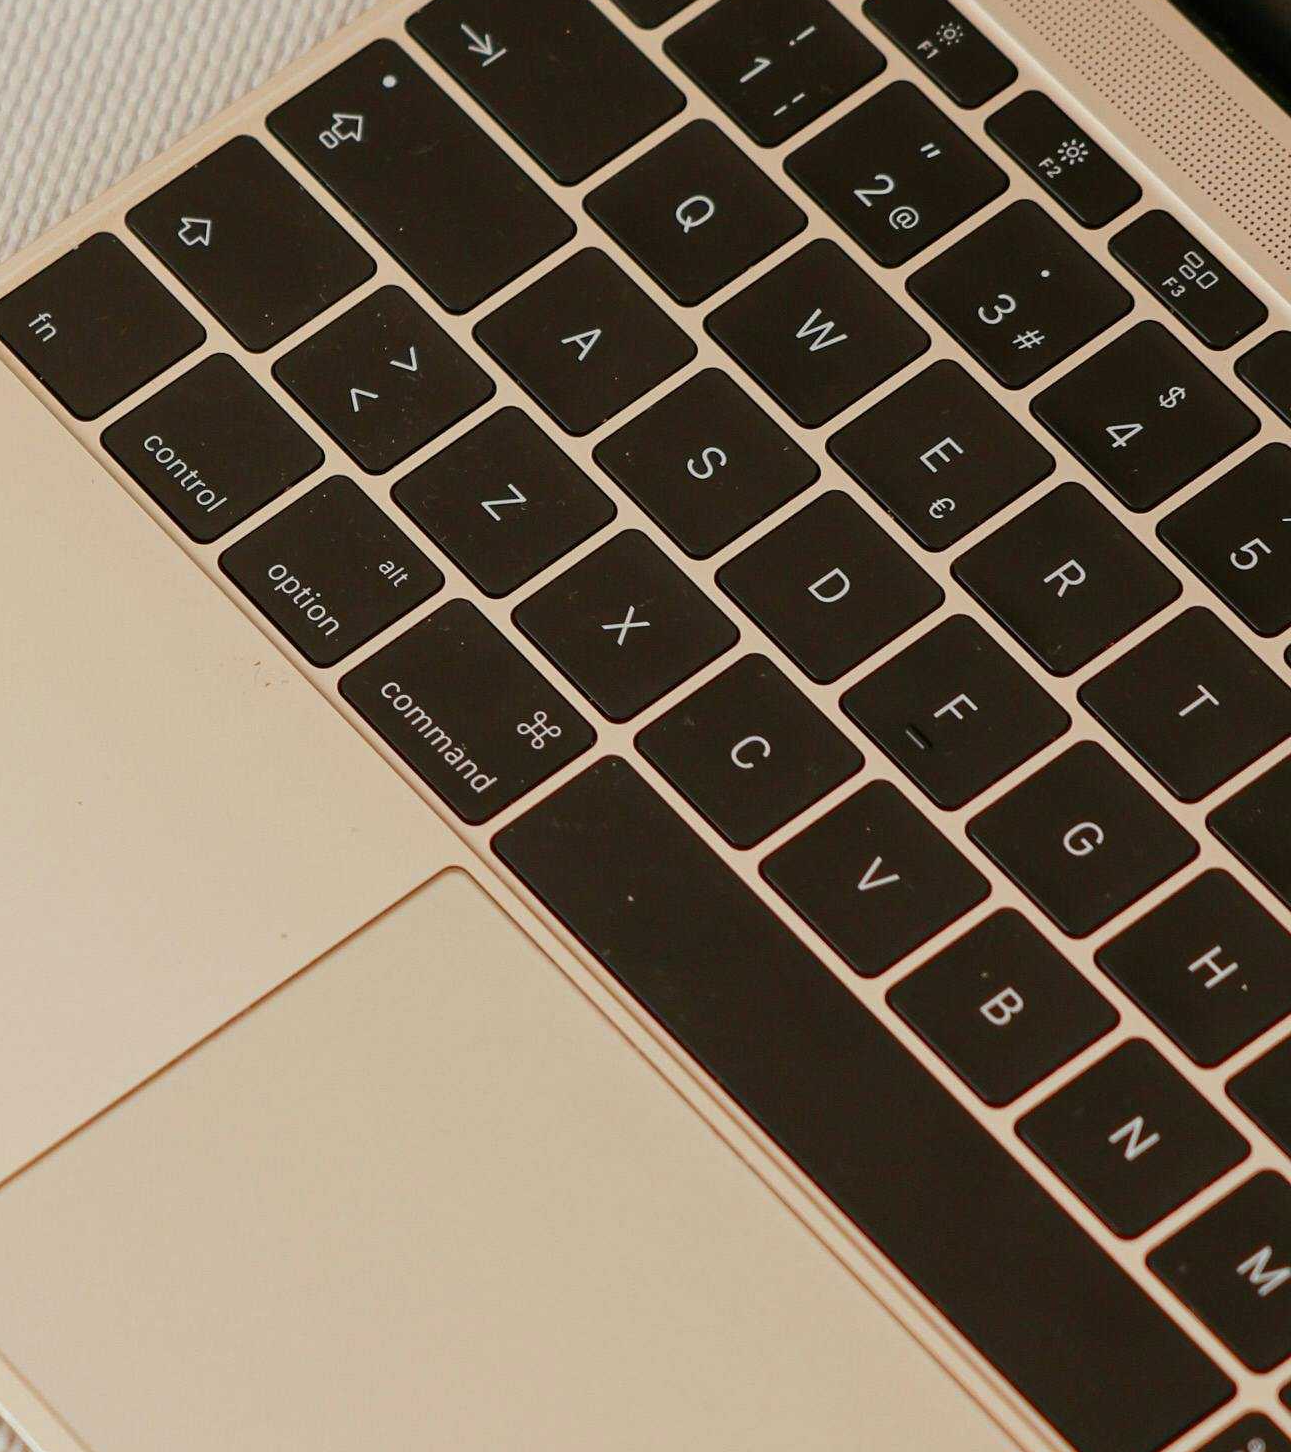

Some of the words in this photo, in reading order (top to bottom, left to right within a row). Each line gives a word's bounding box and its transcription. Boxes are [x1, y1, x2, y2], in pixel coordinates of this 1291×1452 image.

[917, 39, 939, 60] F1
[739, 57, 771, 84] 1
[1038, 156, 1062, 179] F2
[853, 173, 895, 208] 2
[675, 194, 715, 234] Q
[888, 205, 920, 230] @
[1161, 276, 1187, 298] F3
[977, 293, 1017, 325] 3
[28, 312, 57, 342] fn
[795, 307, 848, 352] W
[1012, 329, 1045, 350] #
[560, 328, 602, 362] A
[1158, 386, 1186, 409] $
[1104, 421, 1144, 449] 4
[686, 446, 727, 480] S
[919, 436, 964, 474] E
[143, 434, 228, 513] control
[480, 483, 528, 522] Z
[928, 496, 956, 519] €
[1230, 537, 1272, 570] 5
[378, 558, 409, 588] alt
[807, 567, 851, 603] D
[1043, 559, 1086, 598] R
[267, 561, 340, 637] option
[601, 605, 651, 646] X
[933, 693, 979, 720] F
[1177, 684, 1220, 718] T
[380, 680, 498, 795] command
[730, 735, 771, 770] C
[1063, 821, 1105, 857] G
[857, 855, 901, 891] V
[1187, 945, 1239, 989] H
[979, 986, 1024, 1026] B
[1107, 1114, 1160, 1161] N
[1236, 1245, 1291, 1297] M
